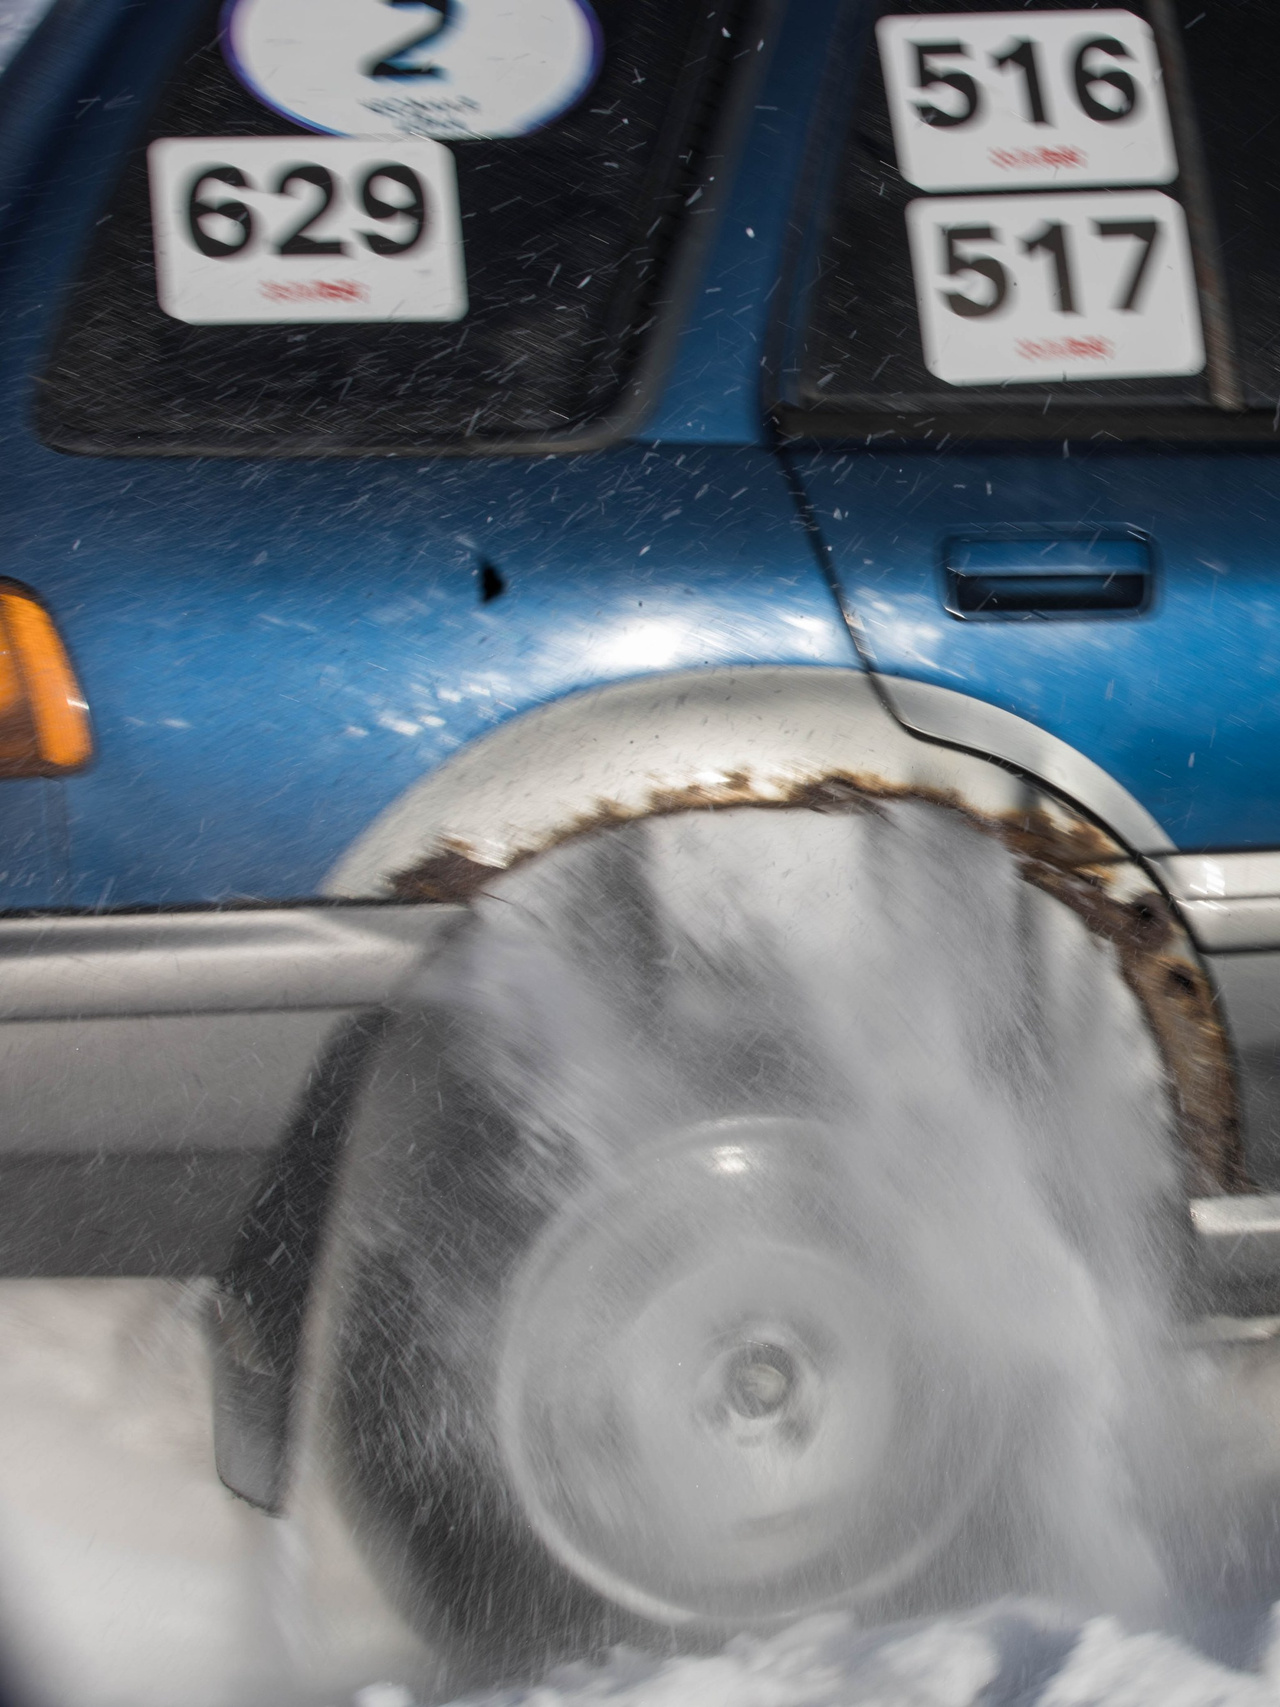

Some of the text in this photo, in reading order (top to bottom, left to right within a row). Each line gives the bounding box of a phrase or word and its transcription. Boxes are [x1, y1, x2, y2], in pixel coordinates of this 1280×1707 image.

[360, 0, 462, 82] 2
[905, 34, 1139, 130] 516
[188, 163, 426, 259] 629
[938, 216, 1163, 321] 517
